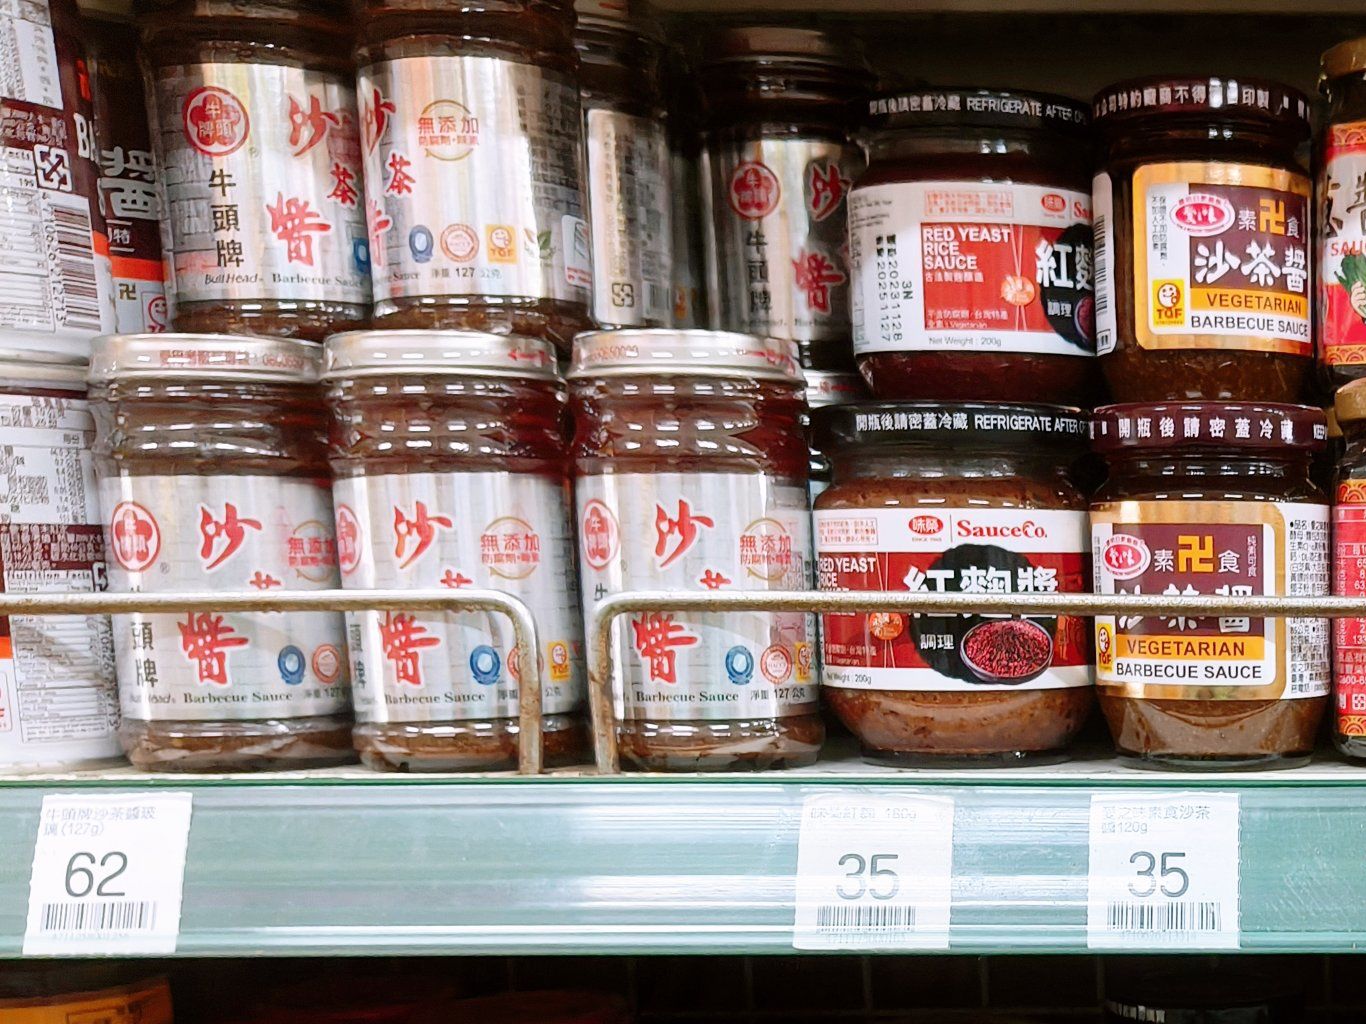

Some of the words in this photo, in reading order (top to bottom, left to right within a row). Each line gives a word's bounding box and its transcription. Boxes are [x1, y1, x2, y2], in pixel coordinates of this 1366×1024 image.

[1207, 293, 1301, 314] VEGETARIAN
[1191, 315, 1275, 332] BARBECUE
[1127, 640, 1245, 656] VEGETARIAN
[1116, 663, 1198, 679] BARBECUE
[1204, 665, 1262, 679] SAUCE
[65, 851, 128, 898] 62
[836, 853, 899, 899] 35
[1127, 851, 1189, 898] 35
